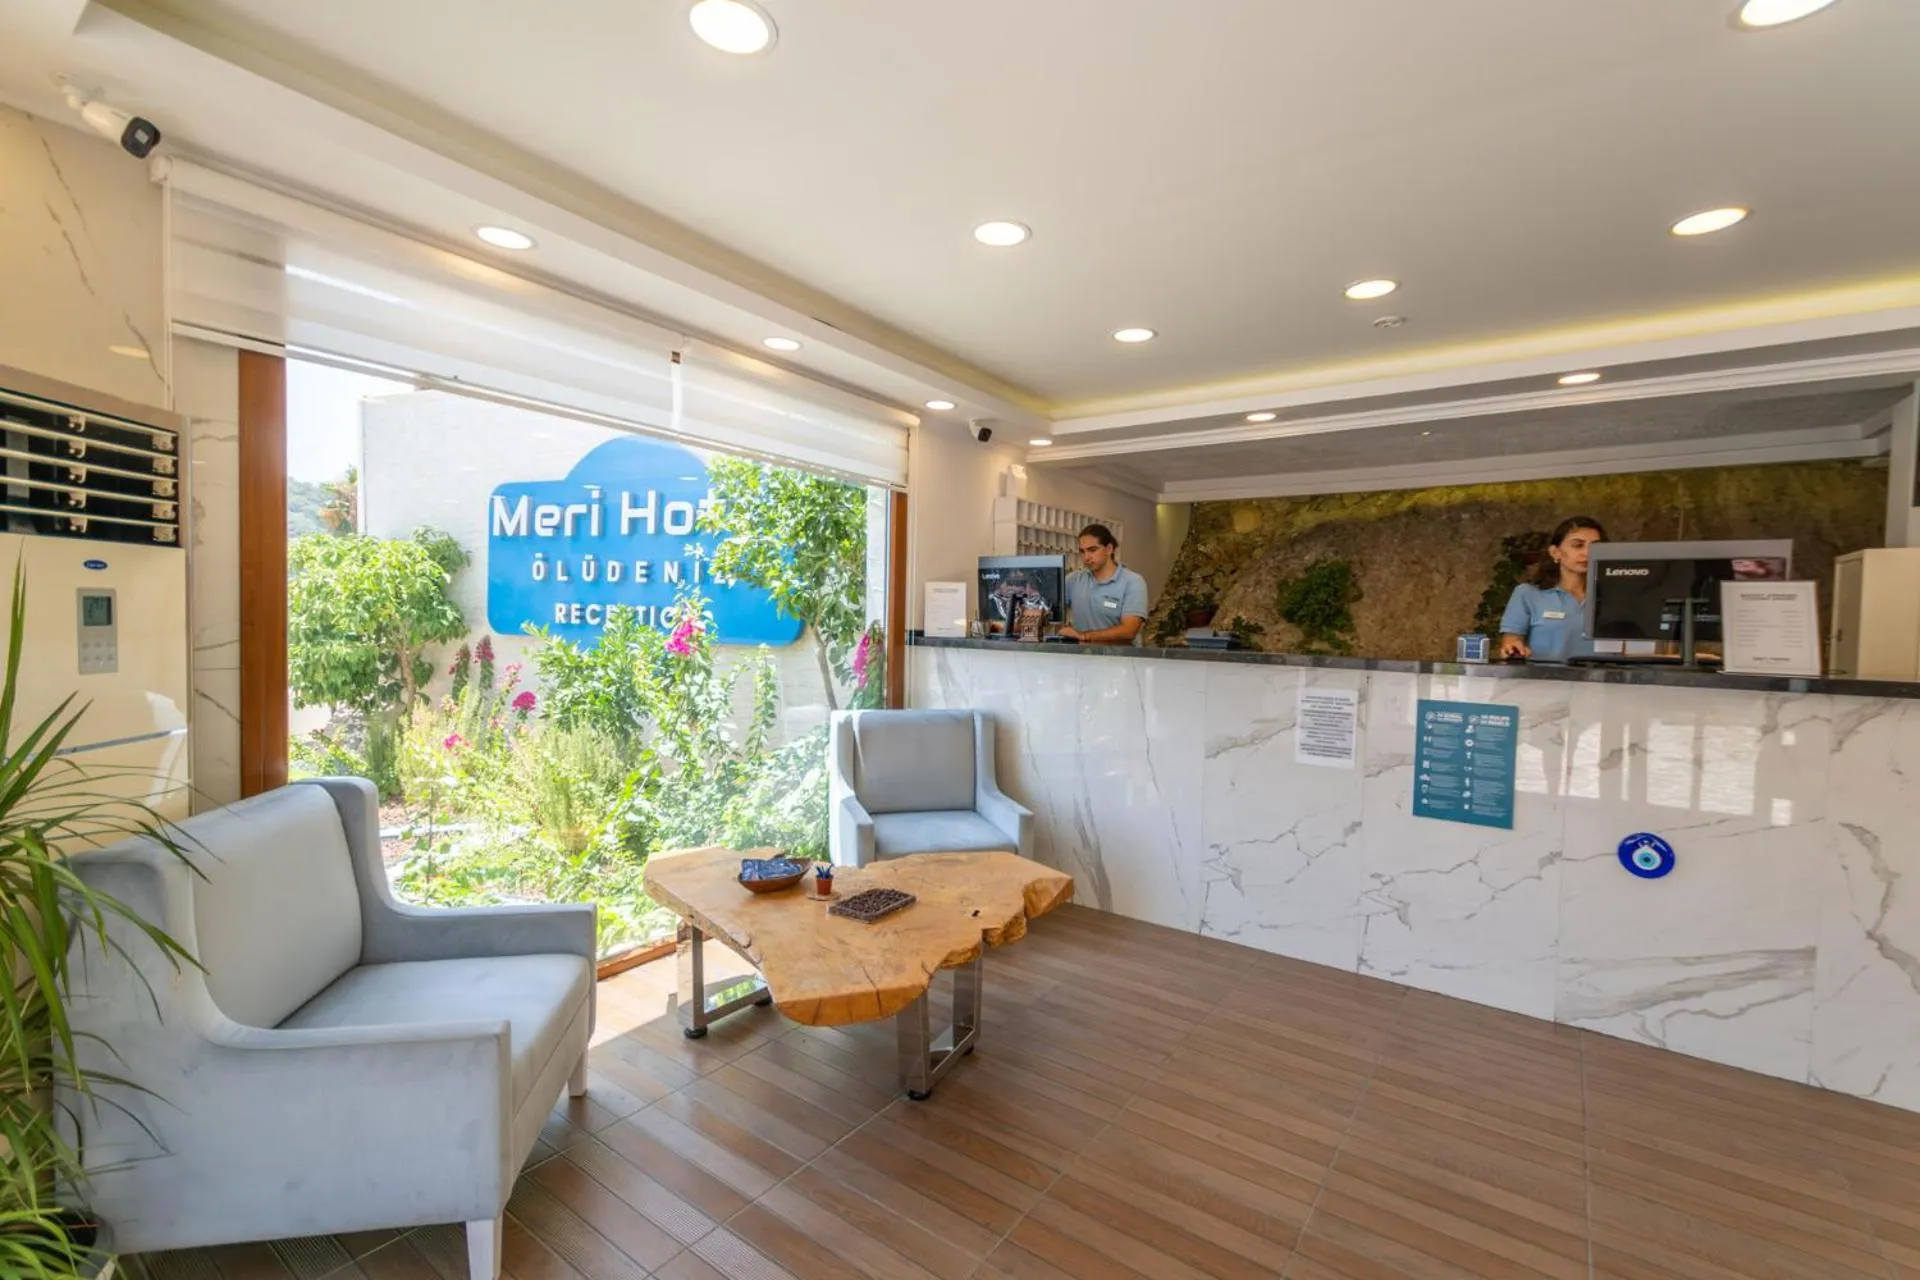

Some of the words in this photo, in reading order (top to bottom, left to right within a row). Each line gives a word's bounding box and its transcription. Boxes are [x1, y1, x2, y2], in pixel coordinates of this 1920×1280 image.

[492, 488, 600, 537] Meri
[1605, 567, 1650, 577] Lenovo
[554, 602, 710, 629] RECETIO
